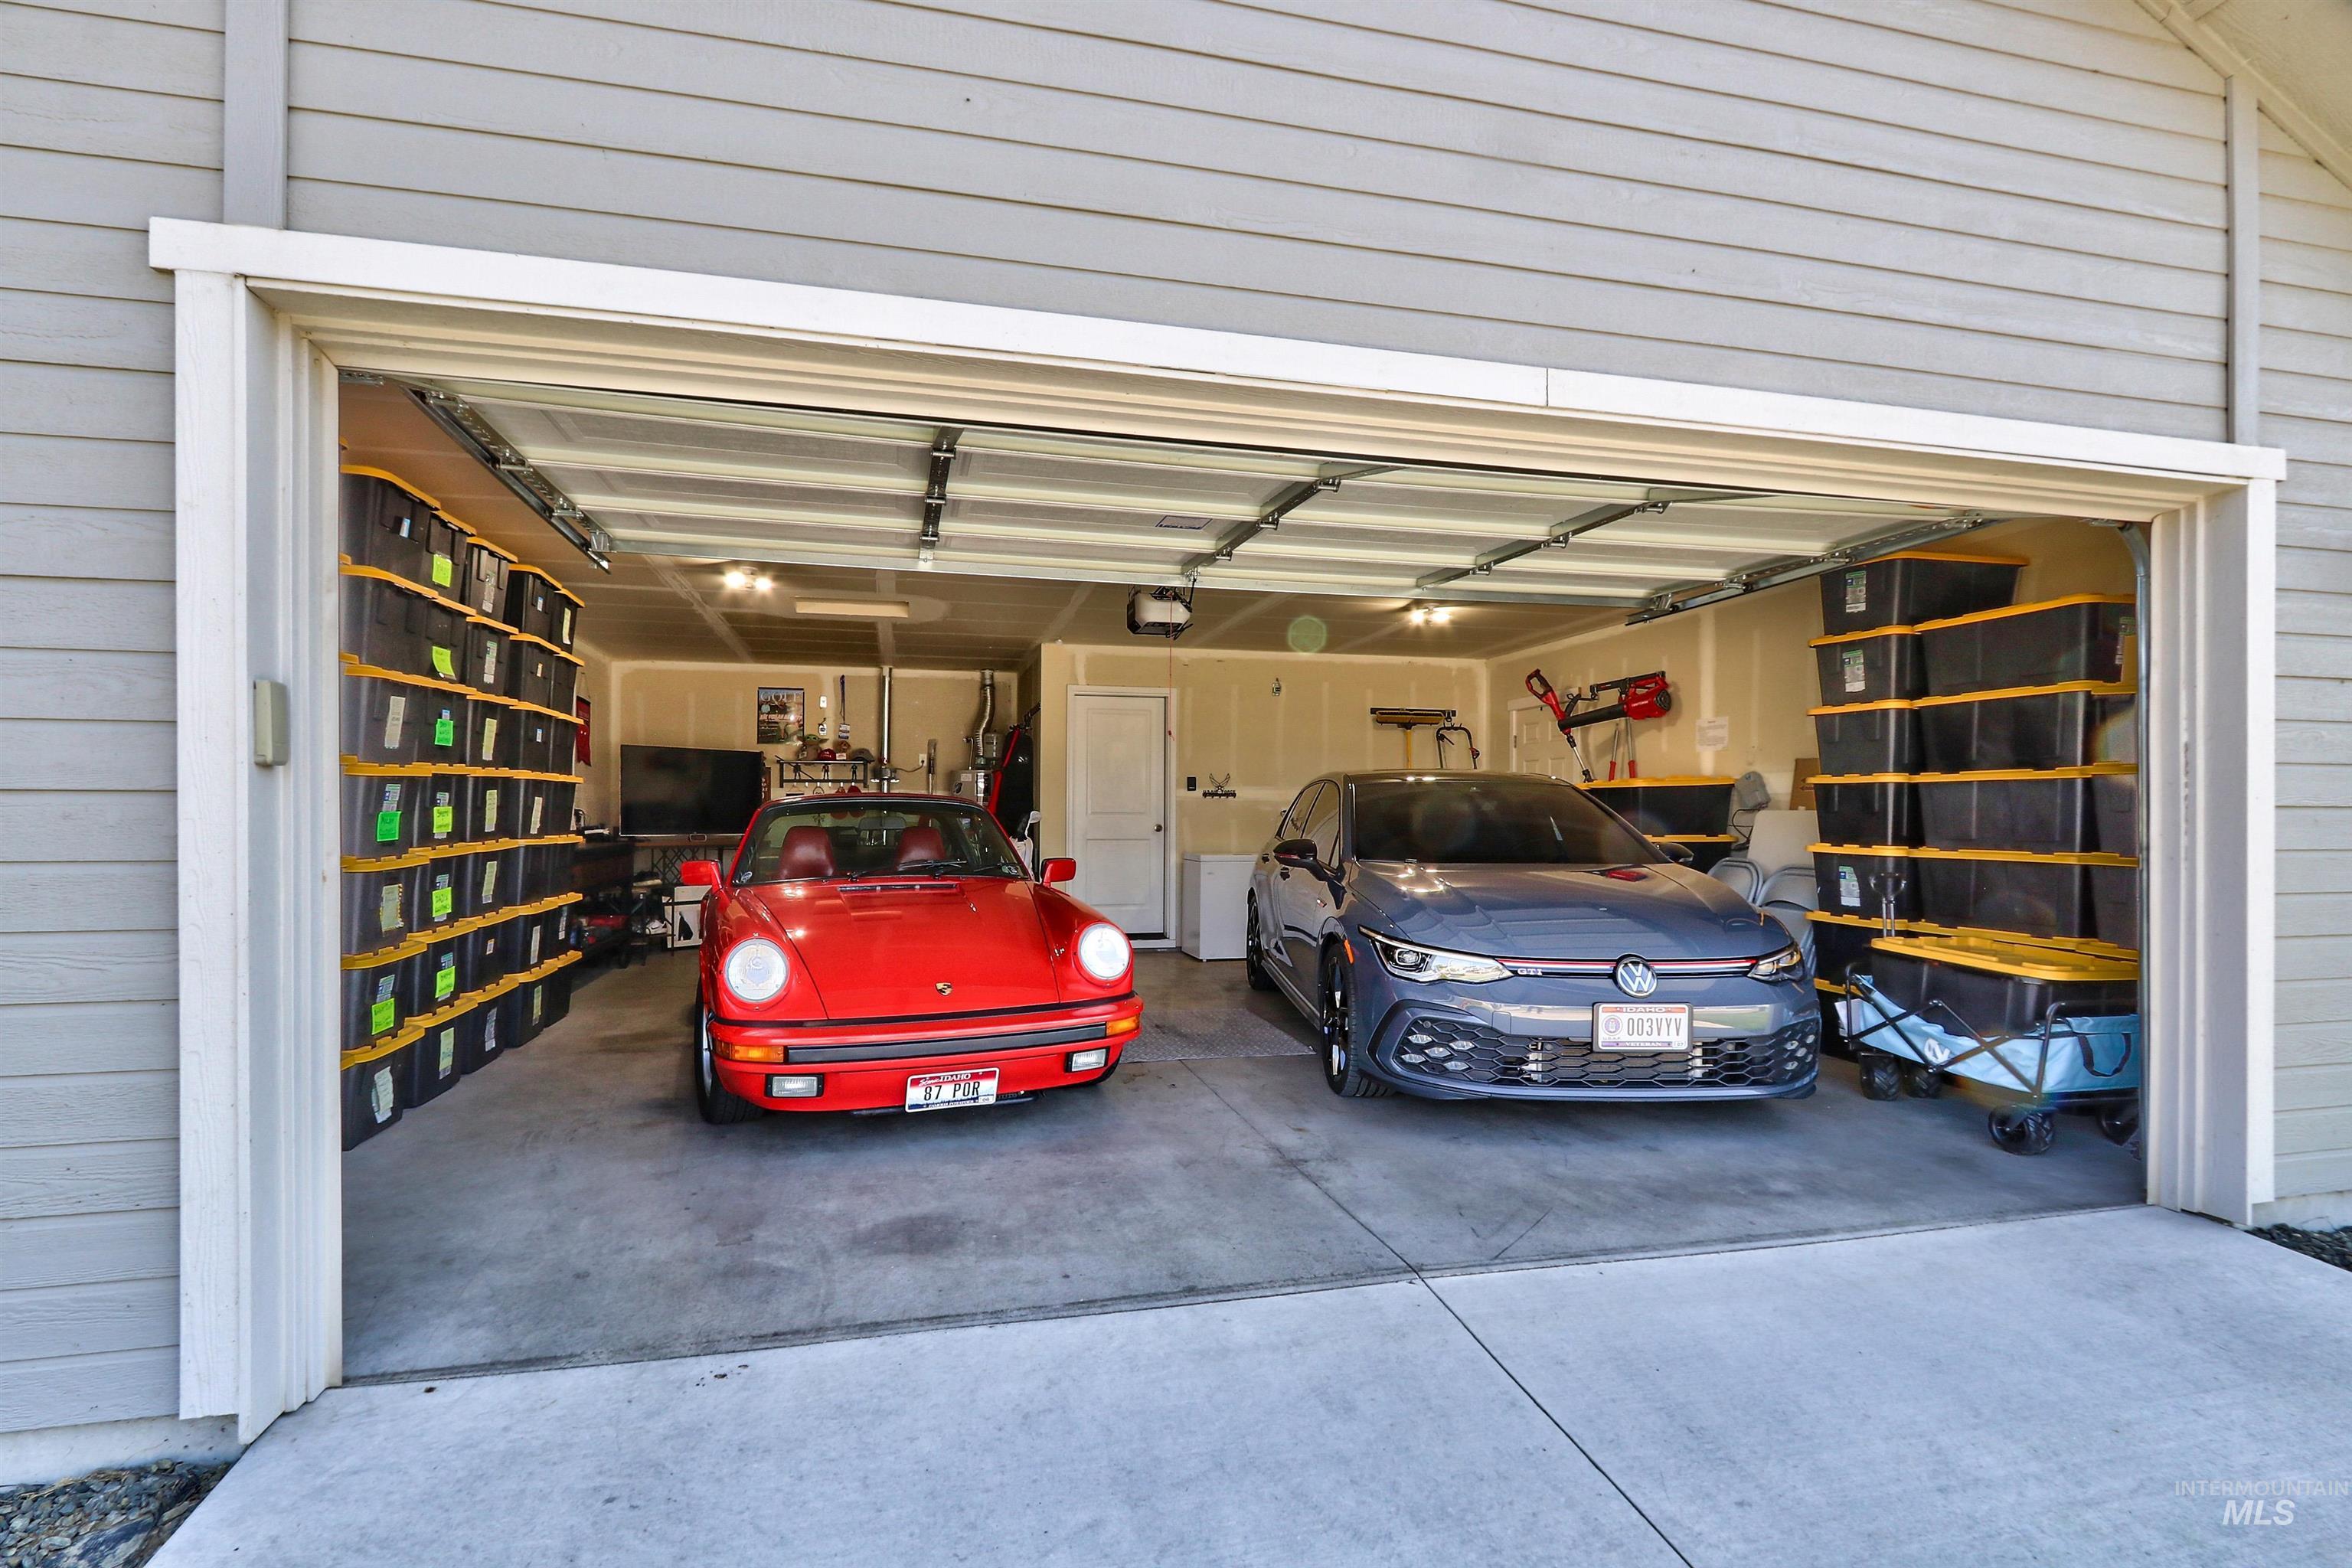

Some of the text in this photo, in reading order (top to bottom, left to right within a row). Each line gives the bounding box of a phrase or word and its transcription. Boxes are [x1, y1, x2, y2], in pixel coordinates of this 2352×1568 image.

[1517, 967, 1544, 976] GTI
[1627, 1018, 1682, 1037] 003VYV
[939, 1073, 971, 1082] IDAHO
[923, 1081, 980, 1101] 87 POR
